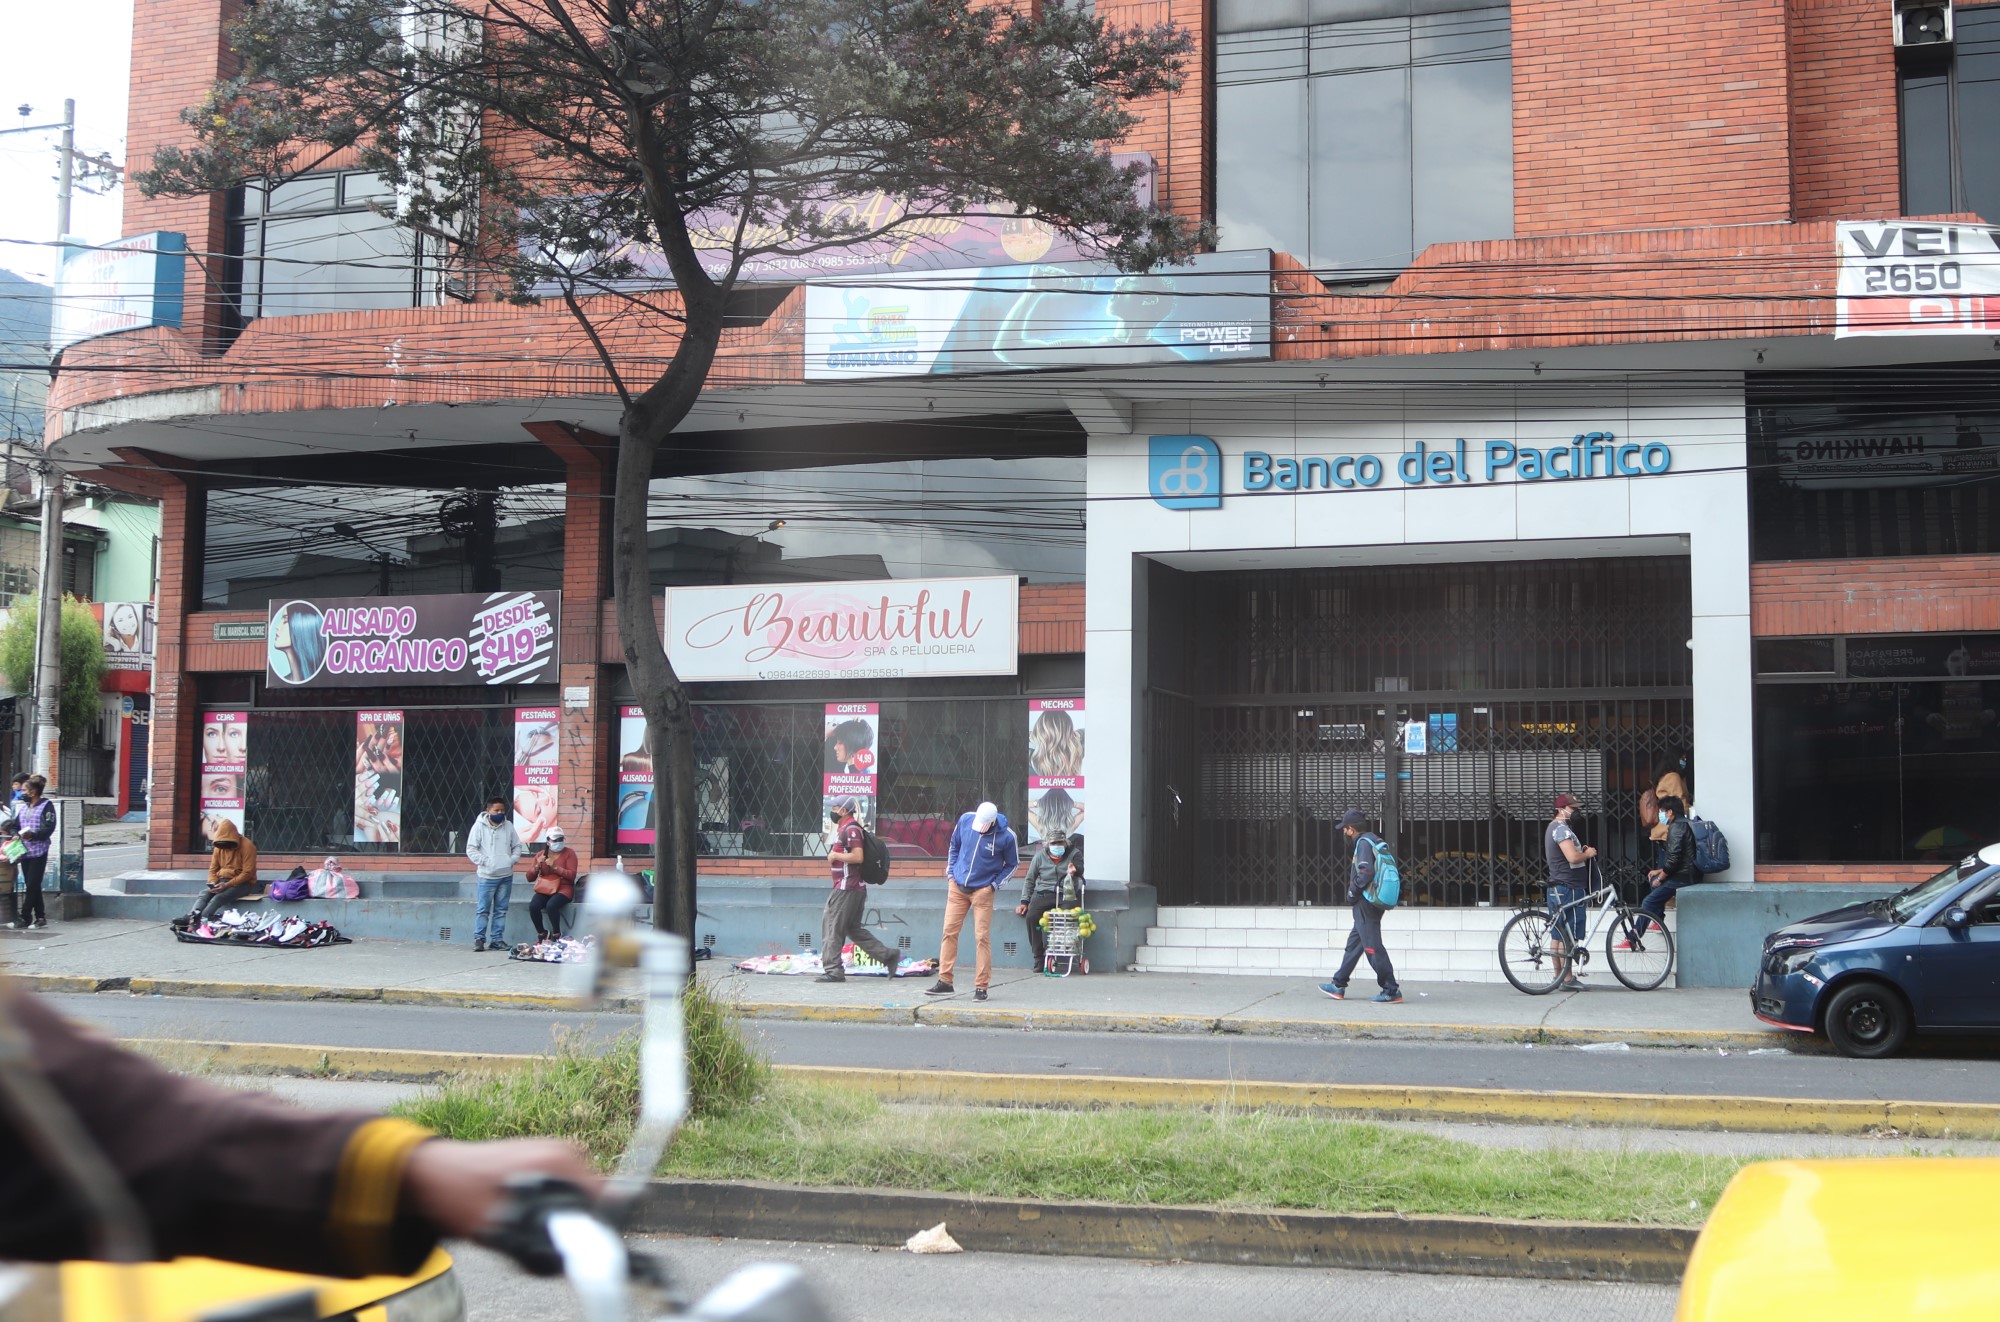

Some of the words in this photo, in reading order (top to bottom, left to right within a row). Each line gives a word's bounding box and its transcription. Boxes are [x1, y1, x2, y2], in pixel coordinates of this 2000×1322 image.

[708, 263, 726, 273] 266
[818, 256, 843, 267] 0985
[1865, 261, 1961, 292] 2650
[1180, 326, 1252, 342] POWER
[827, 349, 918, 369] GIMNASIO
[1243, 449, 1383, 492] Banco
[1397, 438, 1470, 486] del
[1484, 431, 1672, 481] Pacífico
[321, 606, 417, 636] ALISADO
[483, 600, 534, 634] DESDE
[685, 588, 984, 663] Beautiful
[227, 626, 249, 637] MARISCAL
[250, 626, 265, 636] SUCRE
[326, 632, 468, 674] ORGÁNICO
[480, 628, 536, 677] $49
[534, 624, 549, 638] 99
[863, 646, 887, 657] SPA
[890, 645, 899, 656] &
[902, 643, 976, 656] PELUQUERIA
[767, 669, 831, 680] 0984422699
[840, 668, 905, 679] 0983755831
[837, 704, 867, 713] CORTES
[1040, 700, 1074, 709] MECHAS
[216, 713, 235, 721] CEJAS
[360, 713, 372, 721] SPA
[373, 713, 382, 721] DE
[383, 712, 401, 721] UÑAS
[521, 709, 556, 719] PESTAÑAS
[525, 767, 553, 775] LIMPIEZA
[528, 776, 549, 784] FACIAL
[622, 774, 647, 782] ALISADO
[830, 775, 871, 784] MAQUILLAJE
[1039, 777, 1076, 786] BALAYAGE
[828, 785, 873, 794] PROFESIONAL
